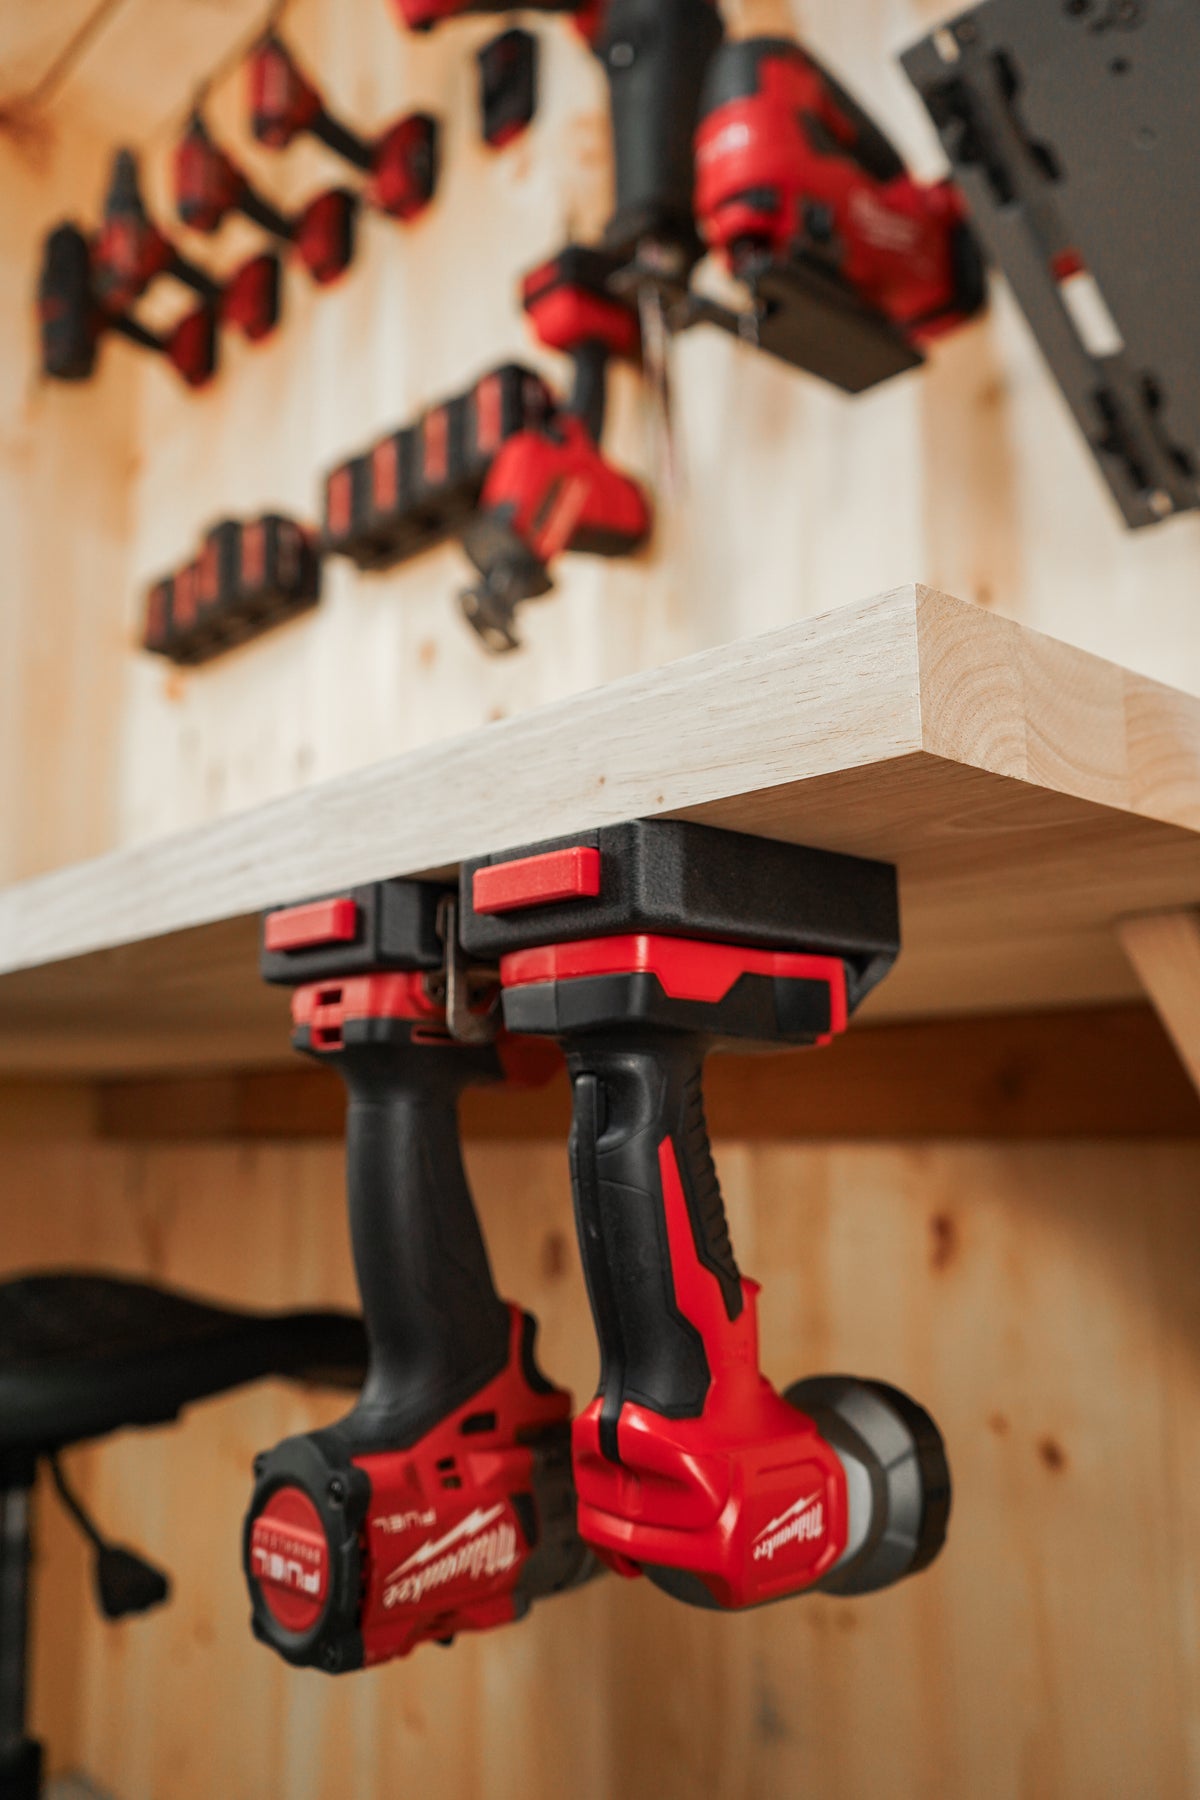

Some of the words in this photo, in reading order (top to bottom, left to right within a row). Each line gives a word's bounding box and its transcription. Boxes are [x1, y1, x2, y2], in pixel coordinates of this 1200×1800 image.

[372, 1508, 436, 1534] FUEL
[252, 1547, 320, 1595] FUEL
[383, 1522, 518, 1609] Milwaukee
